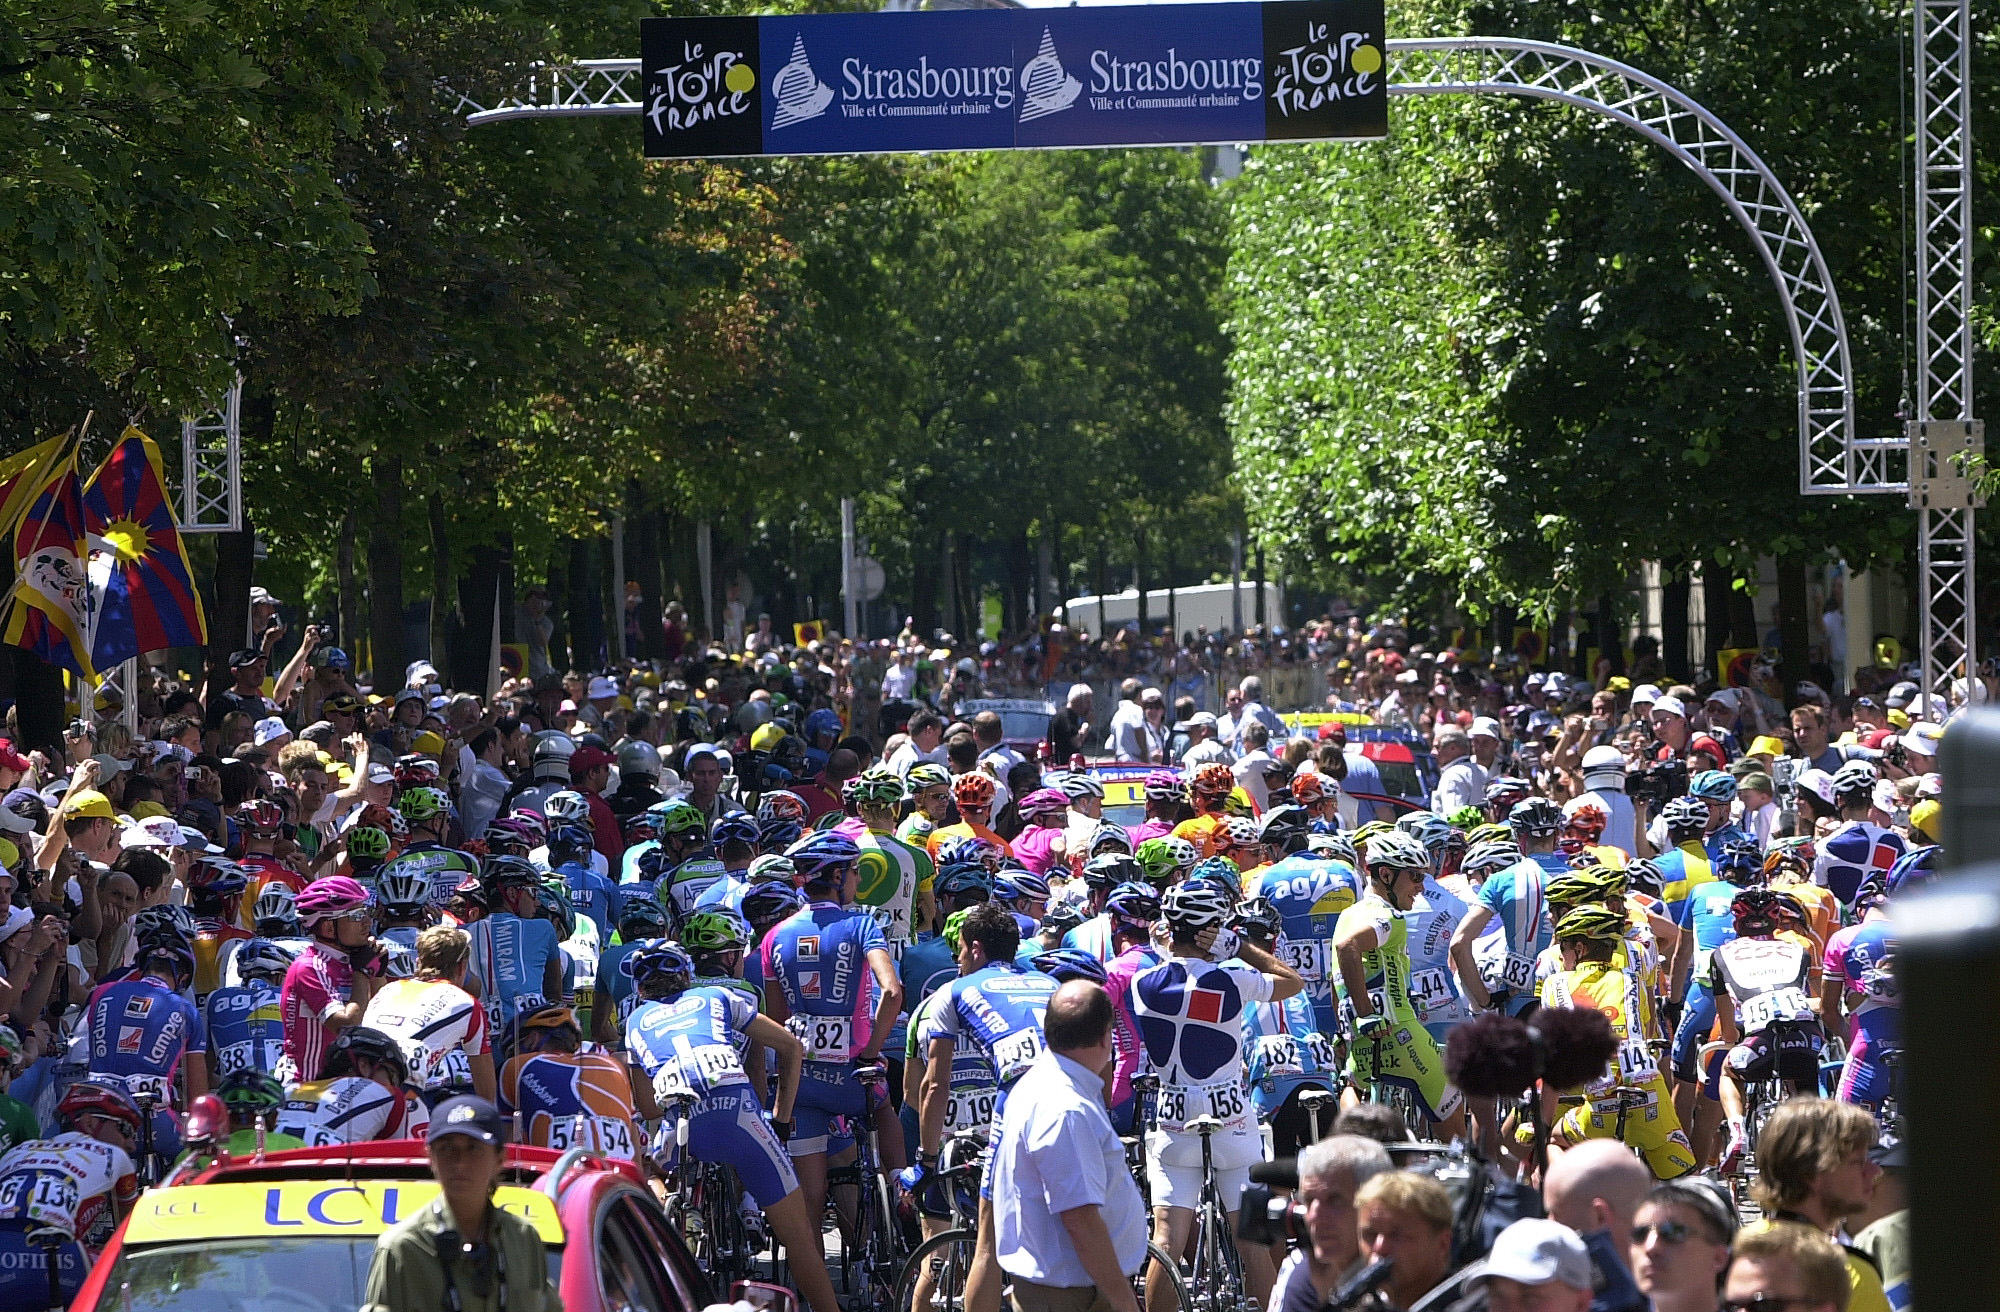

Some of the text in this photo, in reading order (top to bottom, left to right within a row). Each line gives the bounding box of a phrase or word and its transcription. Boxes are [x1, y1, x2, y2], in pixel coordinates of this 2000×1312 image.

[841, 55, 1013, 108] Strasbourg
[1090, 48, 1262, 100] Strasbourg
[841, 101, 991, 118] Ville et Communauté urbaine
[1089, 95, 1240, 111] Ville et Communauté urbaine
[496, 924, 517, 982] MILRAM
[1291, 945, 1314, 970] 33
[826, 941, 853, 1004] Lampre
[1421, 972, 1445, 999] 44
[1503, 957, 1531, 987] 183
[93, 997, 114, 1058] Lampre
[143, 1011, 183, 1065] Lampre
[815, 1023, 843, 1050] 82
[222, 1048, 246, 1074] 38
[1263, 1041, 1299, 1067] 182
[800, 1064, 845, 1086] i'zi:k
[711, 1096, 740, 1111] STEP
[1208, 1087, 1244, 1118] 158
[602, 1122, 630, 1155] 54
[155, 1202, 207, 1216] LCL
